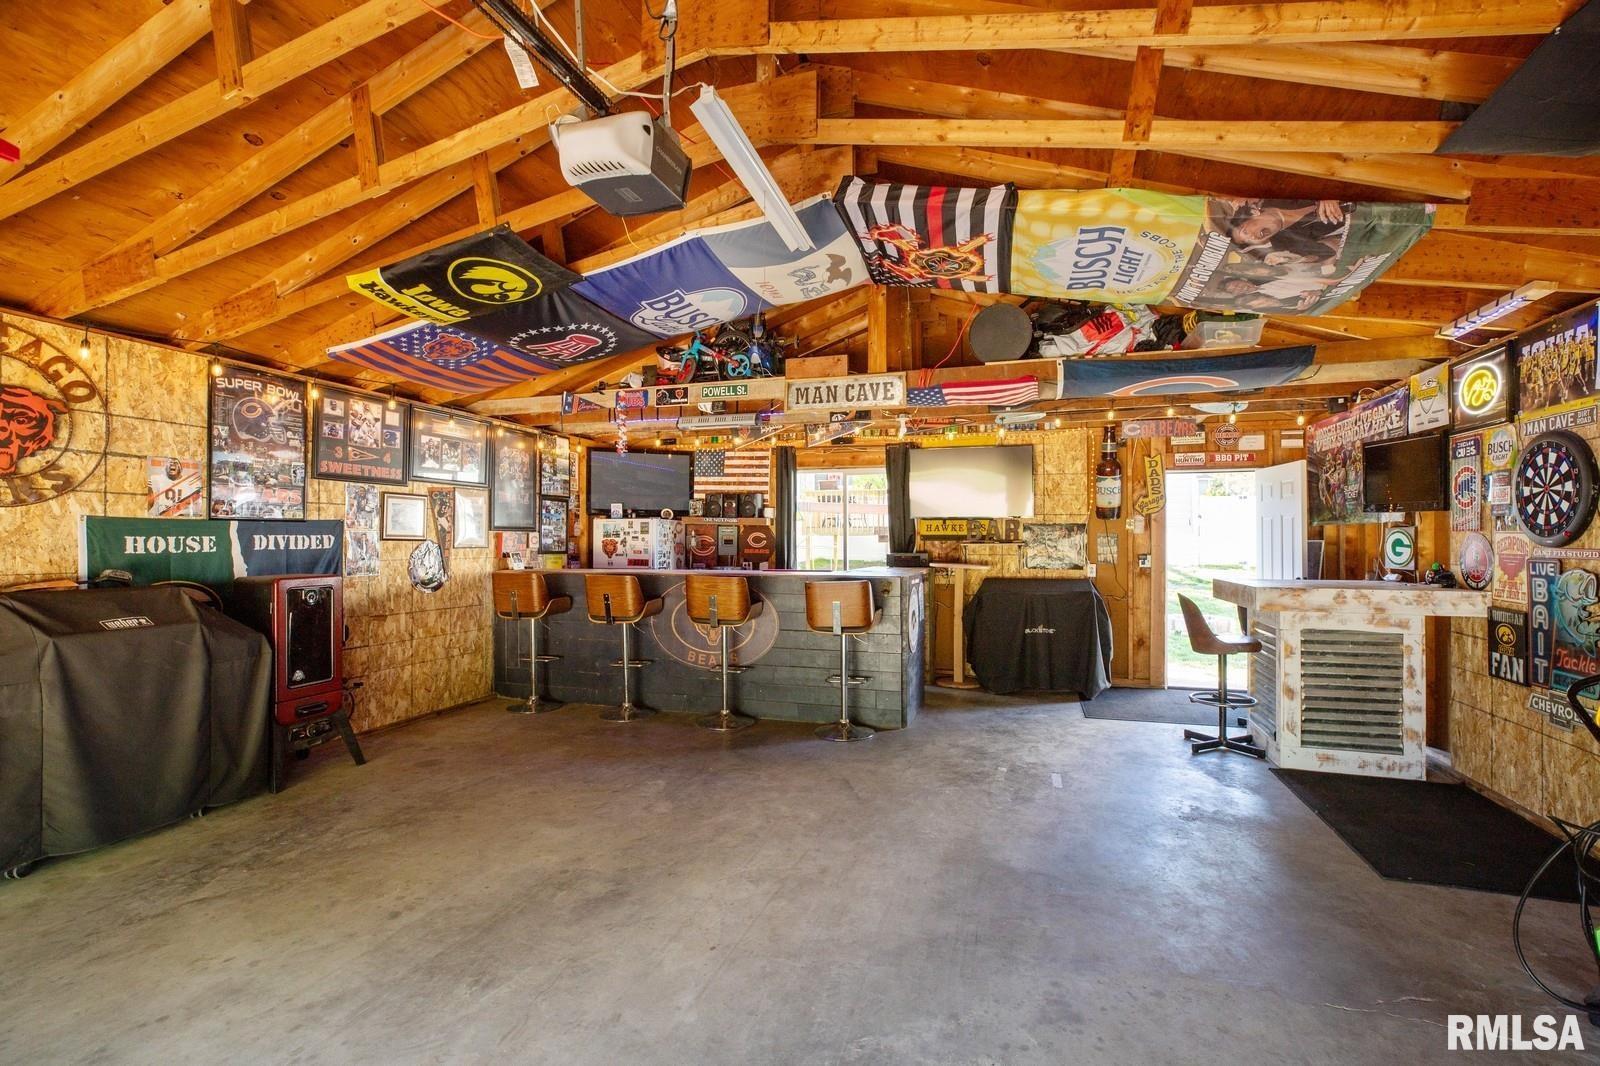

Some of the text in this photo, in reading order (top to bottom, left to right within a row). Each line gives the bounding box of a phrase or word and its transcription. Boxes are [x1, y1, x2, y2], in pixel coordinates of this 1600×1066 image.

[1140, 230, 1178, 249] COBS
[1066, 226, 1126, 291] BUSCH
[1112, 246, 1145, 285] LIGHT
[401, 283, 471, 318] Iowa
[645, 291, 722, 330] BUSC
[215, 377, 303, 404] SUPER BOWL
[703, 386, 735, 397] POWELL
[795, 381, 895, 404] MAN CAVE
[1372, 399, 1397, 419] GAME
[1158, 420, 1198, 437] BEARS
[1371, 410, 1404, 434] HERE
[1526, 410, 1591, 436] MAN CAVE DIRT
[1577, 416, 1592, 425] ROAD
[1215, 454, 1249, 462] BBQ PIT
[1487, 440, 1514, 456] BUSCH
[1492, 453, 1508, 462] LIGHT
[319, 460, 402, 481] SWEETNESS
[1147, 459, 1162, 495] DADS
[1137, 495, 1164, 513] Garage
[926, 523, 987, 533] HAWKES
[966, 519, 1021, 542] BAR
[124, 535, 217, 555] HOUSE
[253, 534, 335, 551] DIVIDED
[1553, 550, 1567, 558] FIX
[1566, 550, 1600, 558] STUPID
[1529, 562, 1556, 577] LIVE
[104, 618, 140, 629] weber
[1531, 577, 1550, 684] BAIT
[687, 650, 739, 666] BEAS
[1491, 652, 1524, 684] FAN
[1556, 648, 1598, 675] Tackle
[1532, 697, 1584, 723] CHEVROL
